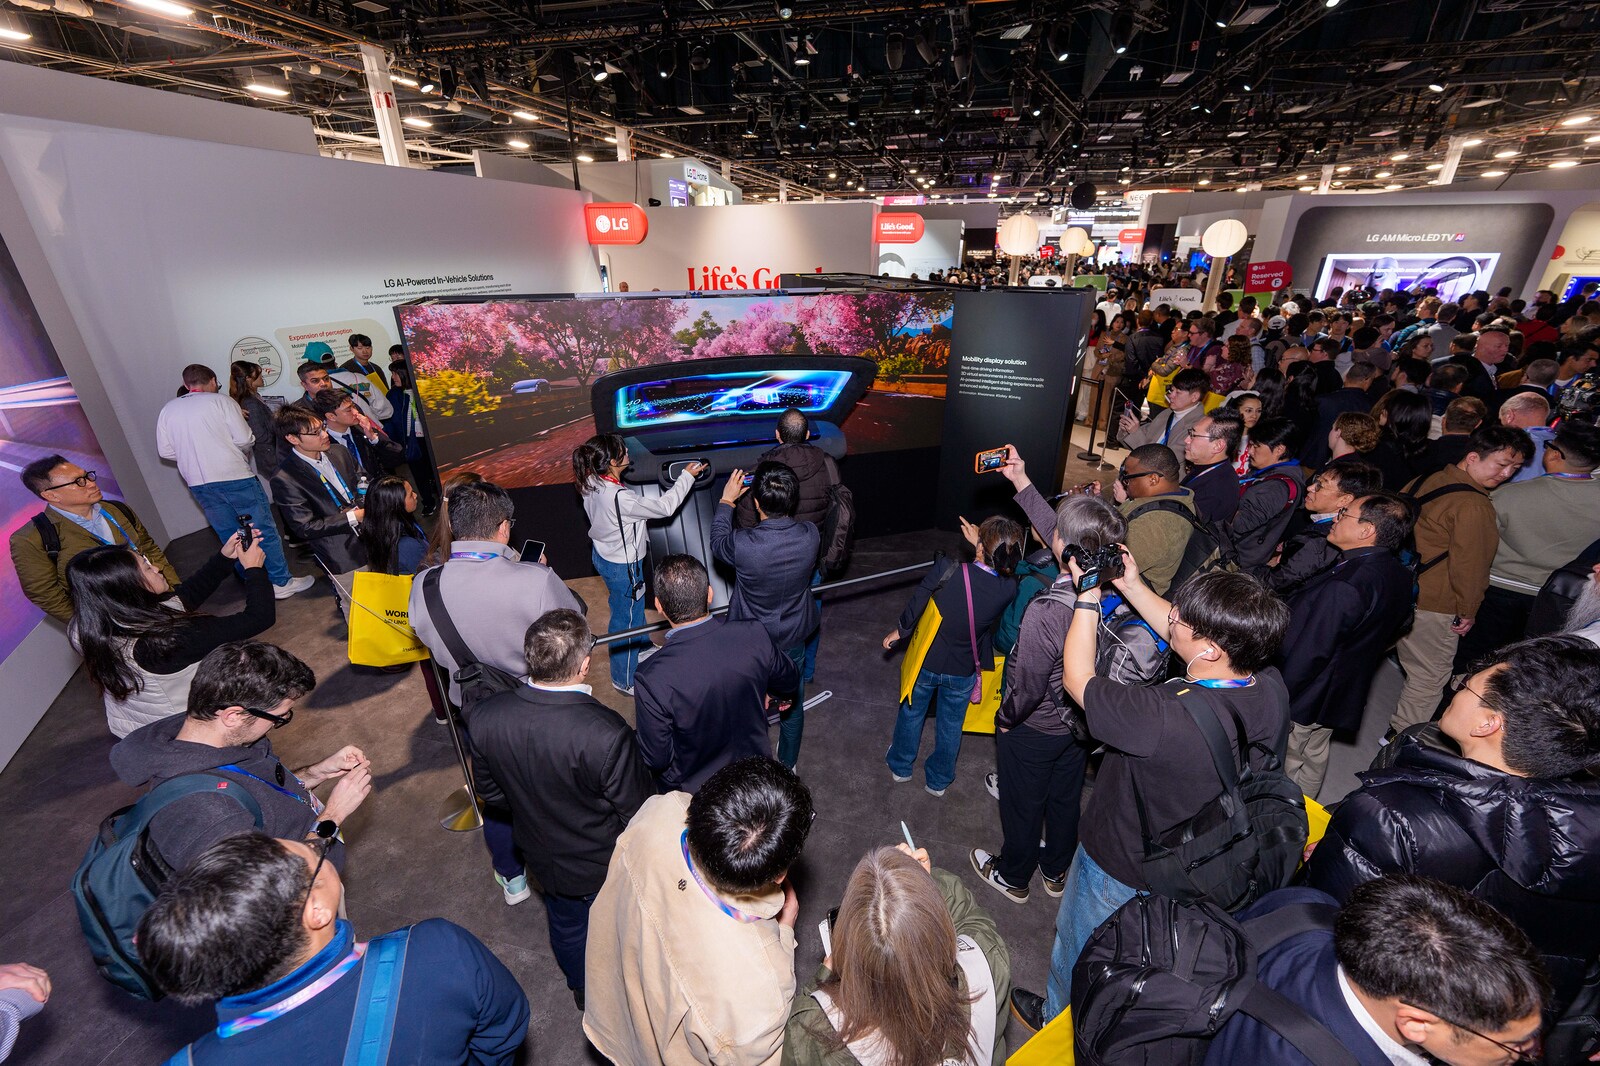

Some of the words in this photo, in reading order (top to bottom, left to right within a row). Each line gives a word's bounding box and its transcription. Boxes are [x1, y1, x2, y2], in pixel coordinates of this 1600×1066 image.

[612, 217, 629, 231] LG
[1366, 234, 1379, 242] LG
[1396, 234, 1421, 242] Micro
[1421, 234, 1440, 242] LED
[1441, 233, 1455, 242] TV
[384, 279, 395, 288] LG
[396, 276, 436, 287] AI-Powered
[437, 275, 467, 284] In-Vehicle
[468, 274, 494, 282] Solutions
[687, 266, 748, 290] Life's
[1252, 271, 1283, 279] Reserved
[289, 333, 318, 341] Expansion
[326, 328, 352, 336] perception
[962, 355, 983, 364] Mobility
